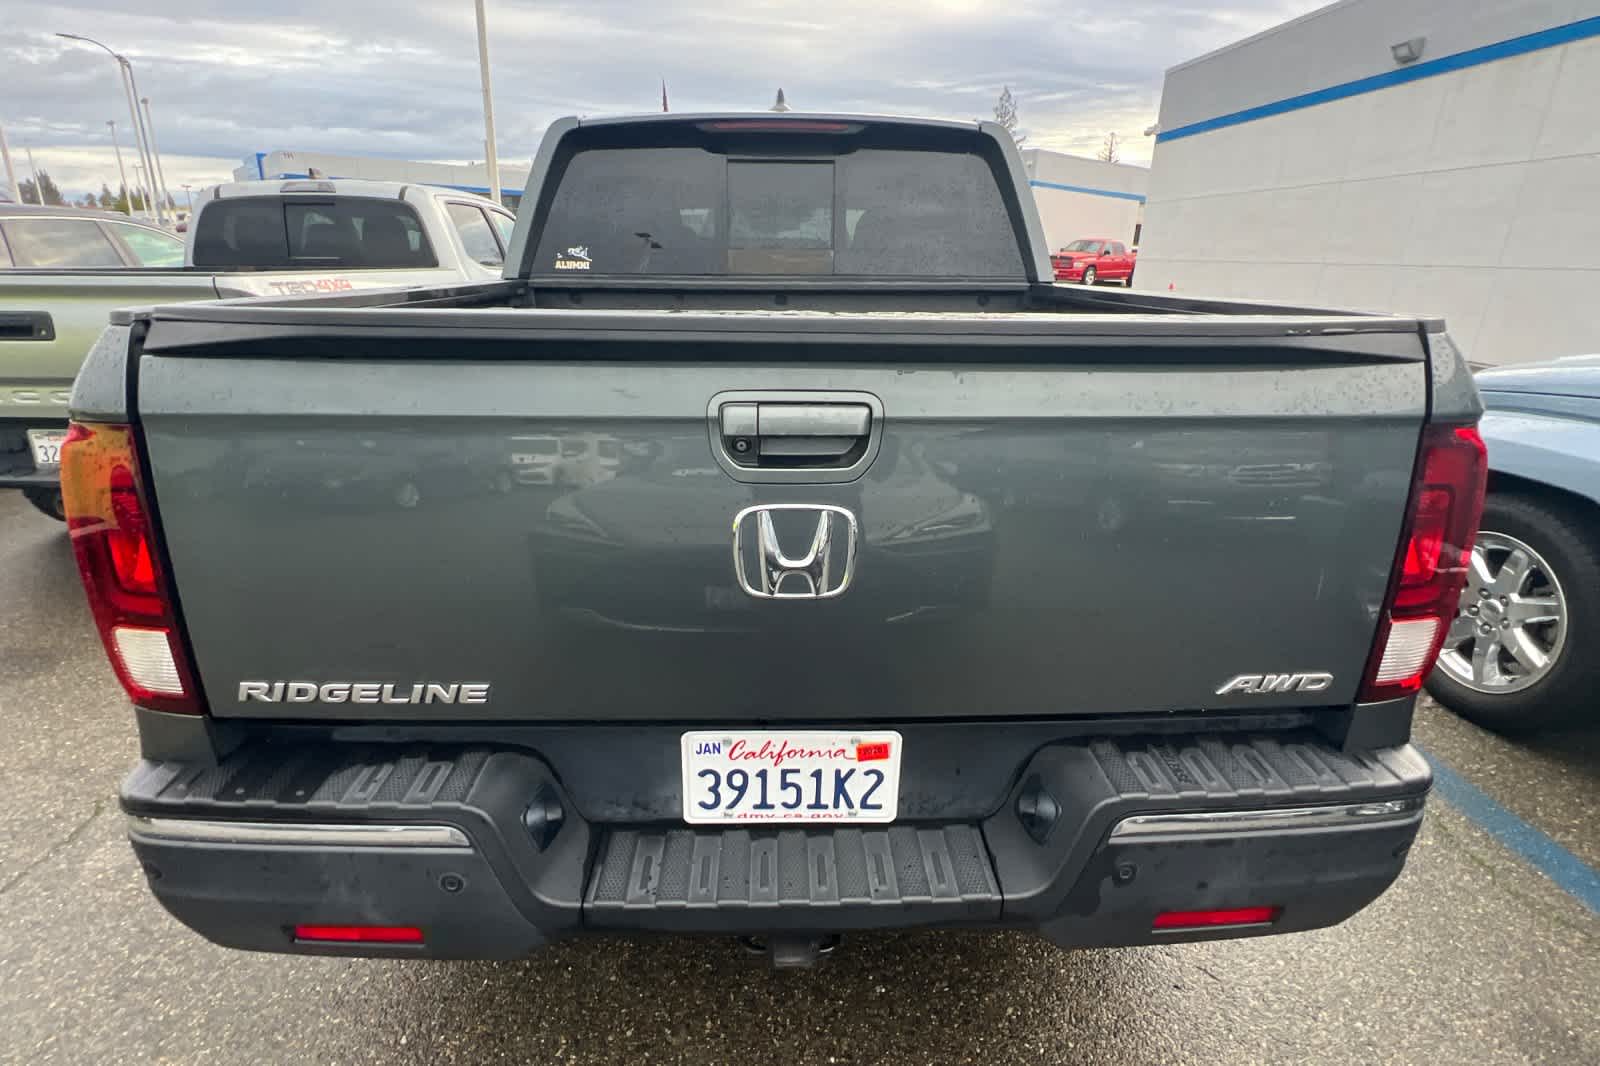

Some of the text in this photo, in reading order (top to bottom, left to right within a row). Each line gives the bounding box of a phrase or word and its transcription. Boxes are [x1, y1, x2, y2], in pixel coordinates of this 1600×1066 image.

[238, 680, 490, 705] RIDGELINE
[1215, 672, 1334, 696] AWD
[695, 742, 721, 756] JAN
[728, 739, 856, 767] California
[697, 768, 885, 810] 39151K2
